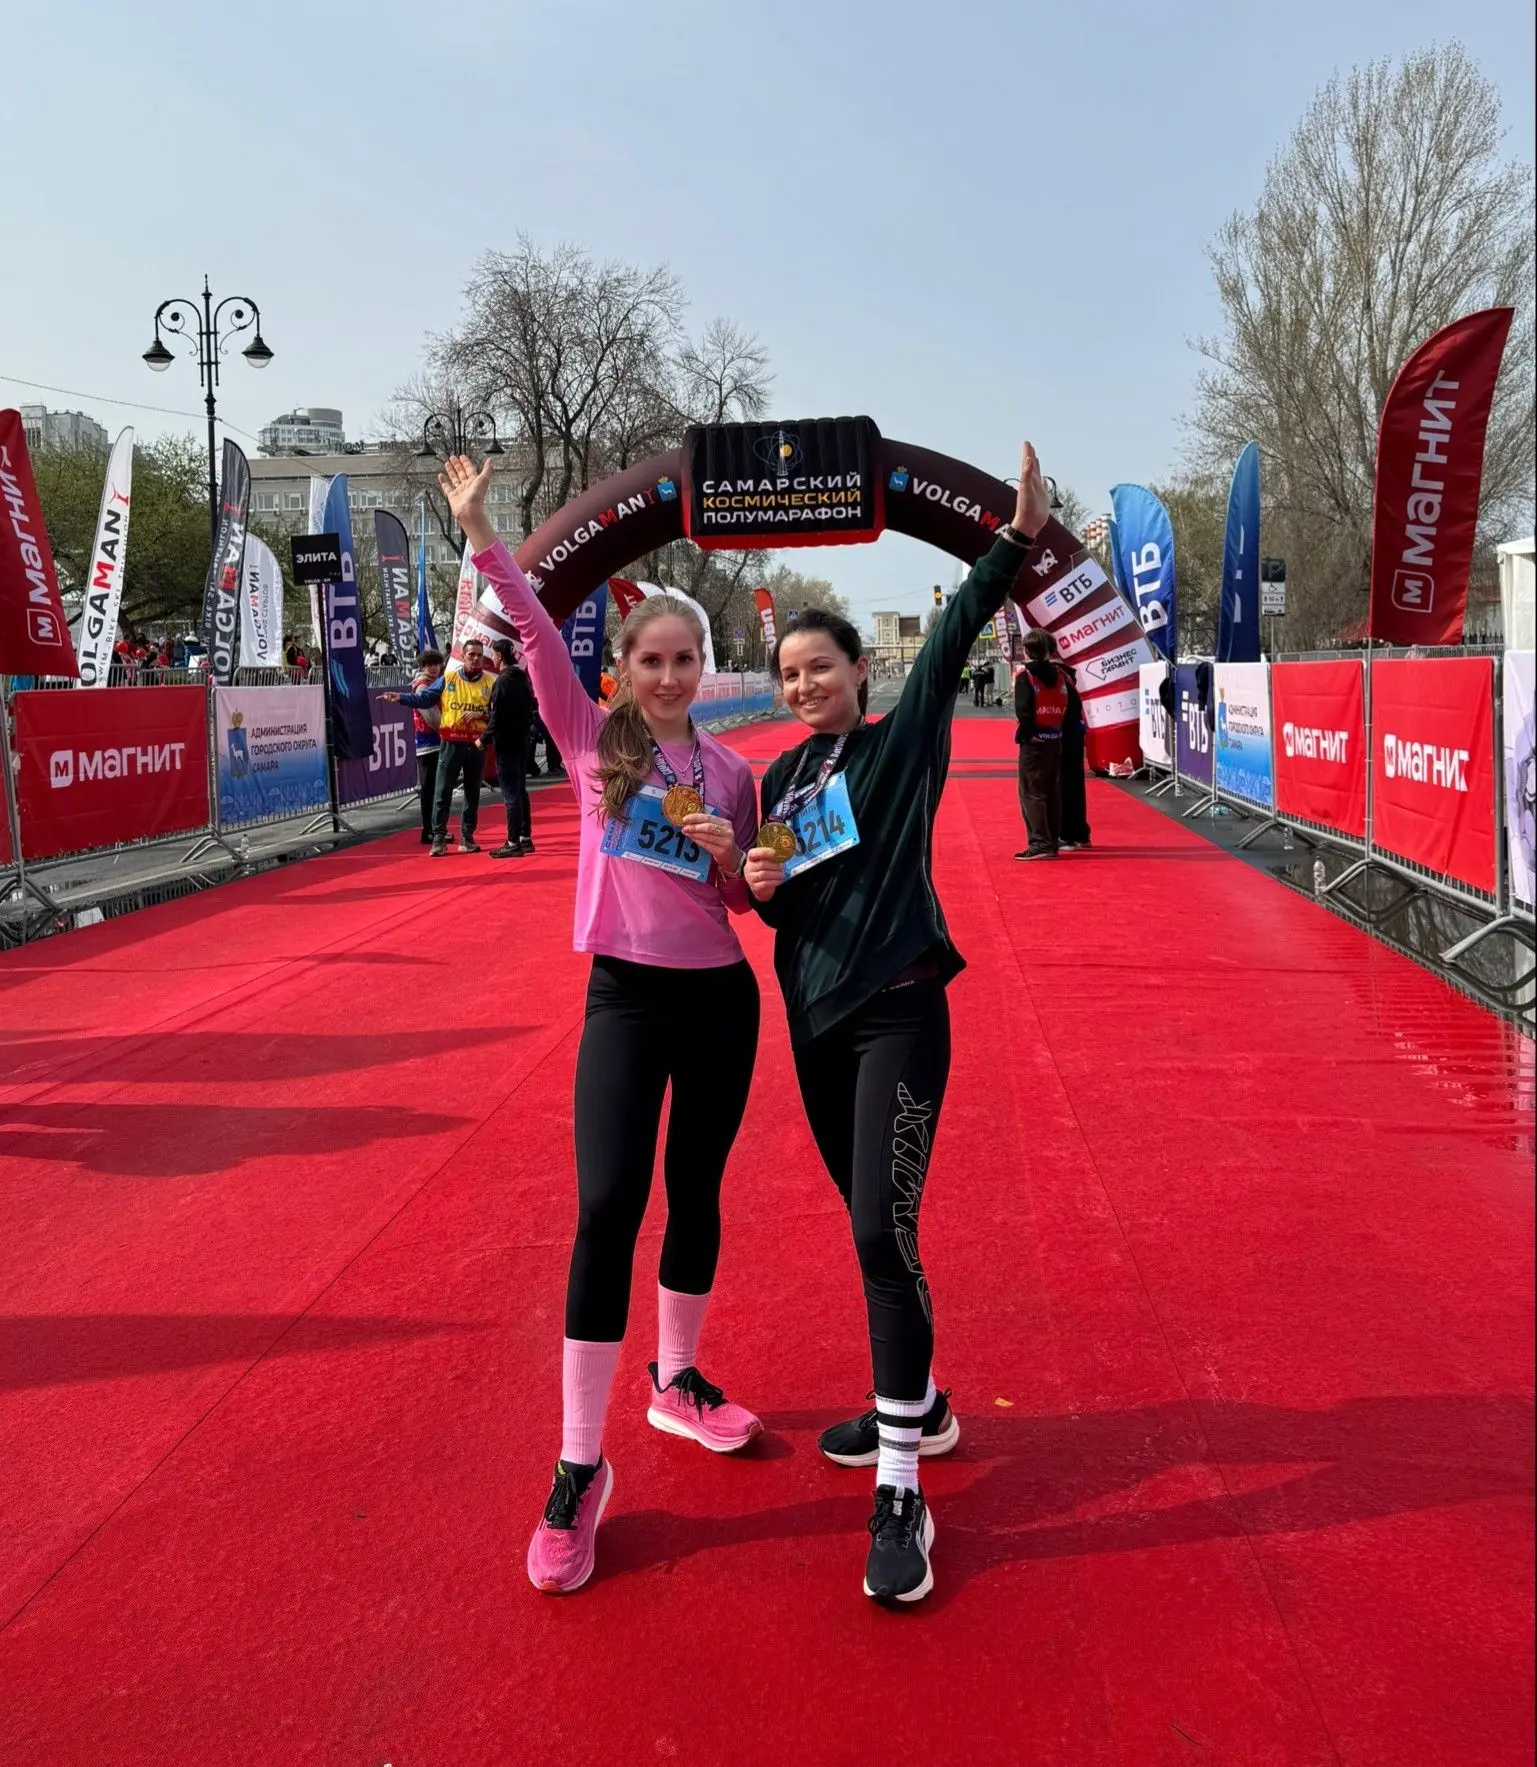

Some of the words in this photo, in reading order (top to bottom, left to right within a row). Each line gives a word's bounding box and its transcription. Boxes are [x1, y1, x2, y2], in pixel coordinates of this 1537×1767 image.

[702, 472, 861, 493] САМАРСКИЙ
[703, 488, 861, 508] КОСМИЧЕСКИЙ
[912, 477, 1011, 540] VOLGAMA
[703, 506, 861, 525] ПОЛУМАРАФОН
[539, 493, 646, 573] VOLGAMAN
[296, 551, 337, 564] ЭЛИТА
[81, 509, 121, 687] OLGAMAN
[1060, 573, 1093, 603] ВТБ
[1131, 542, 1168, 633] ВТБ
[571, 600, 597, 657] ВТБ
[1070, 605, 1126, 643] магнит
[1100, 648, 1137, 667] БИЗНЕС
[1101, 657, 1134, 675] ГАРАНТ
[251, 723, 308, 739] АДМИНИСТРАЦИЯ
[1294, 726, 1349, 764] магнит
[79, 742, 185, 782] магнит
[251, 741, 293, 756] ГОРОДСКОГО
[294, 739, 317, 752] ОКРУГА
[252, 760, 279, 773] САМАРА
[1398, 740, 1470, 792] магнит
